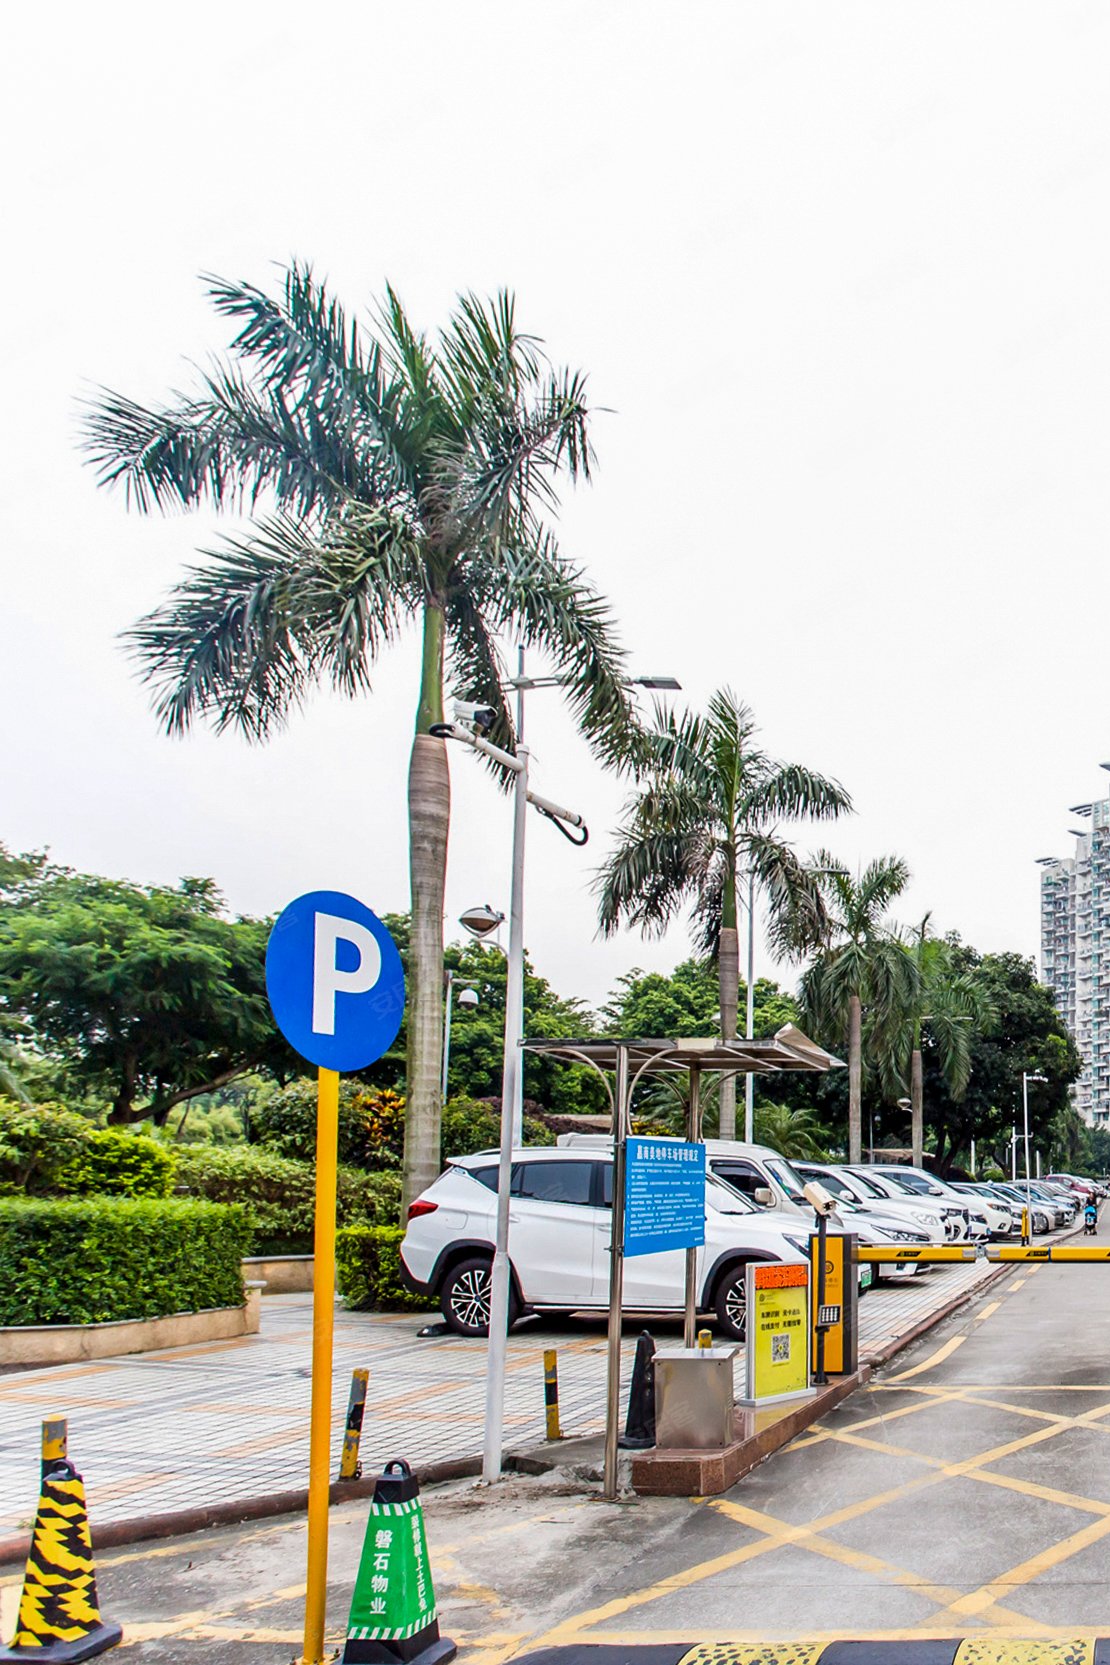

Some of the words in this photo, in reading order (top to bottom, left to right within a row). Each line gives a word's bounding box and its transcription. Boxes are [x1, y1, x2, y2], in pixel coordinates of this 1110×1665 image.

[312, 911, 382, 1036] P
[369, 1529, 393, 1615] 磐石物业
